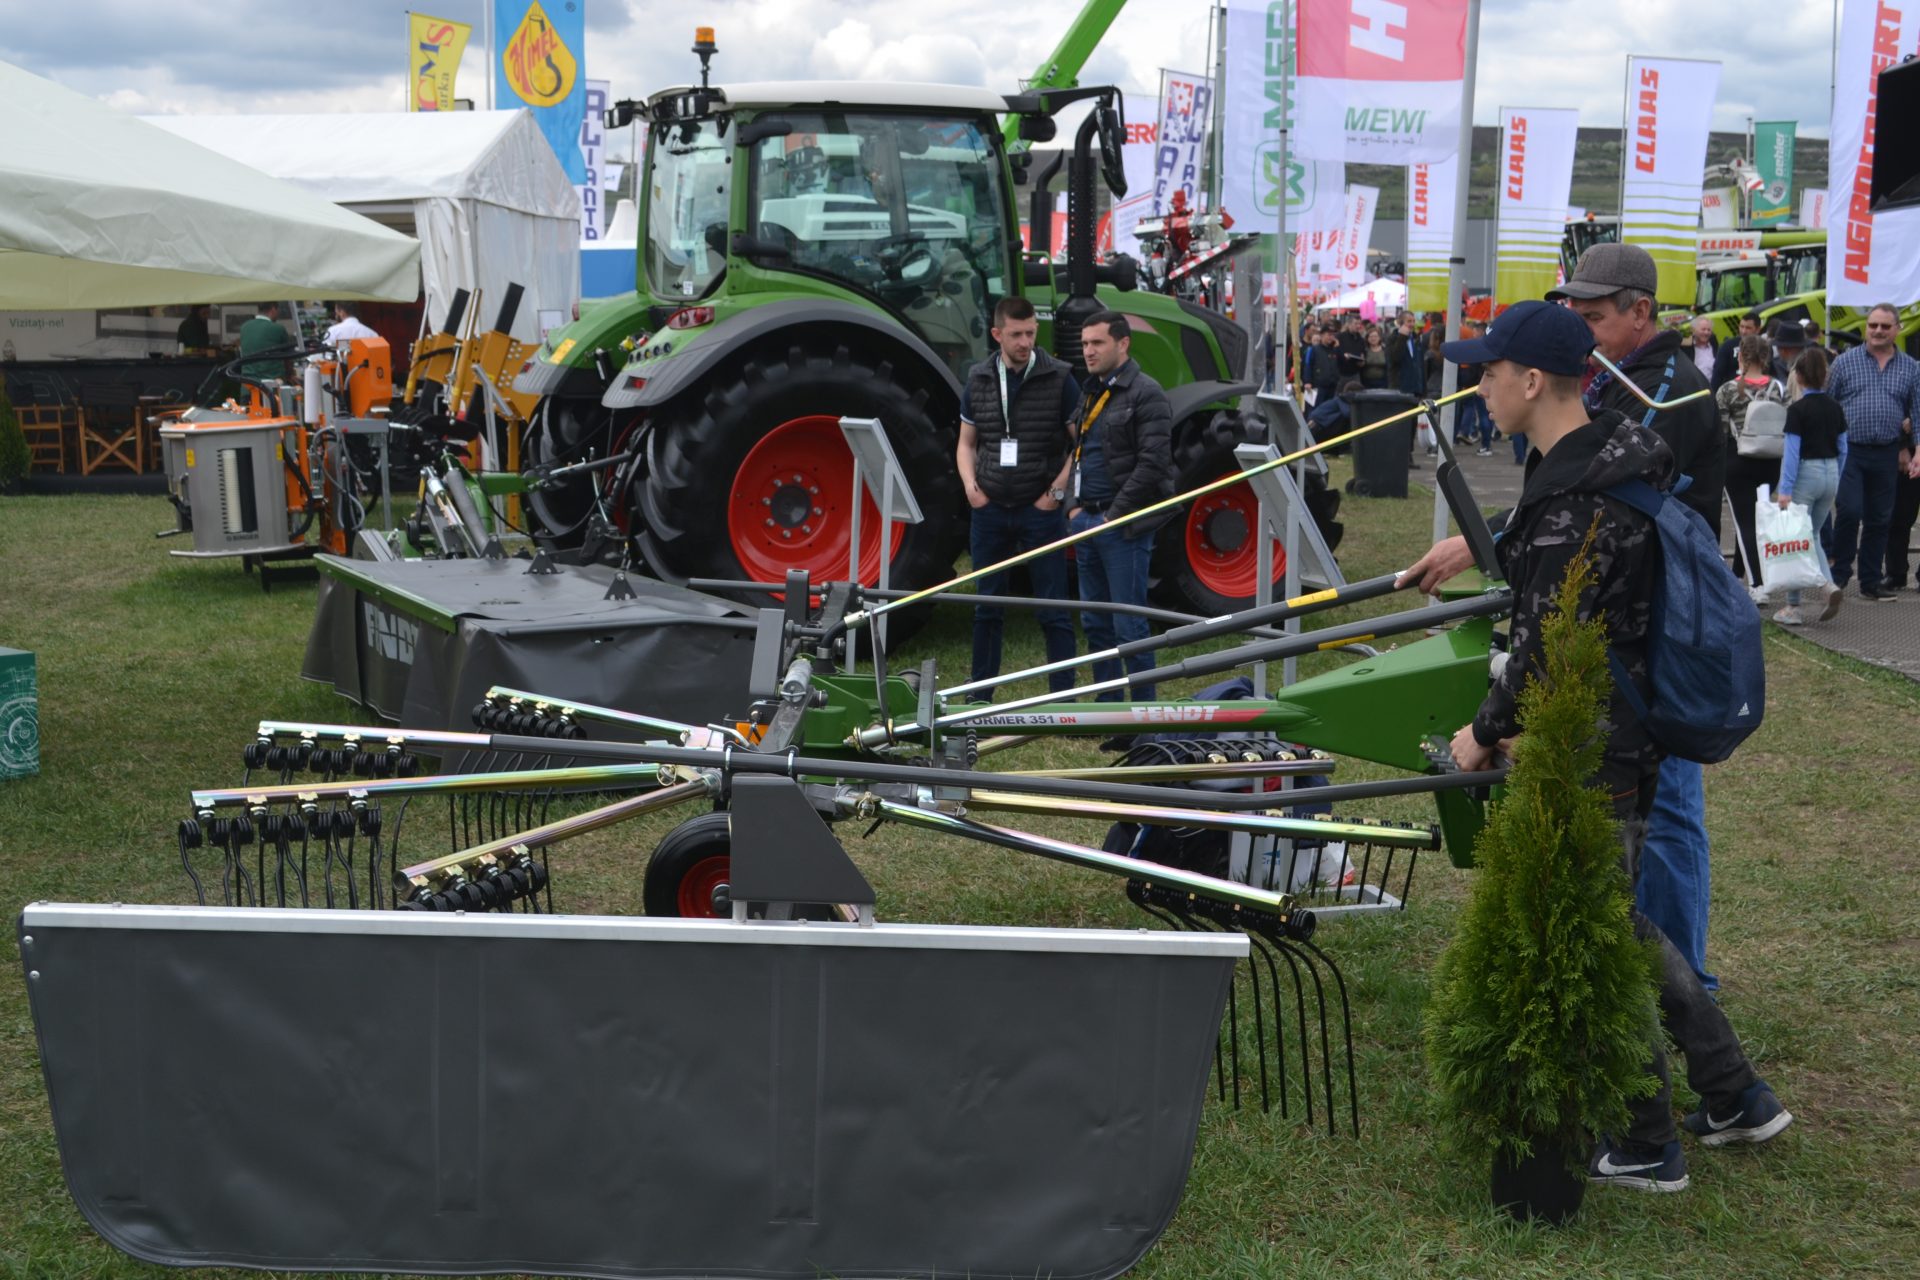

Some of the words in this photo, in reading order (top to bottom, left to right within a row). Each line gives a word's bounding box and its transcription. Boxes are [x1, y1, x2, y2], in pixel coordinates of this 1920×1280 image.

[417, 22, 455, 112] CMS
[1344, 106, 1427, 134] MEWI
[1635, 67, 1659, 174] CLAAS
[1507, 115, 1527, 201] CLAAS
[1701, 239, 1754, 250] CLAAS
[1764, 538, 1810, 558] Ferma
[1030, 715, 1055, 724] 351
[1059, 715, 1077, 724] DN
[1131, 705, 1220, 721] FENDT
